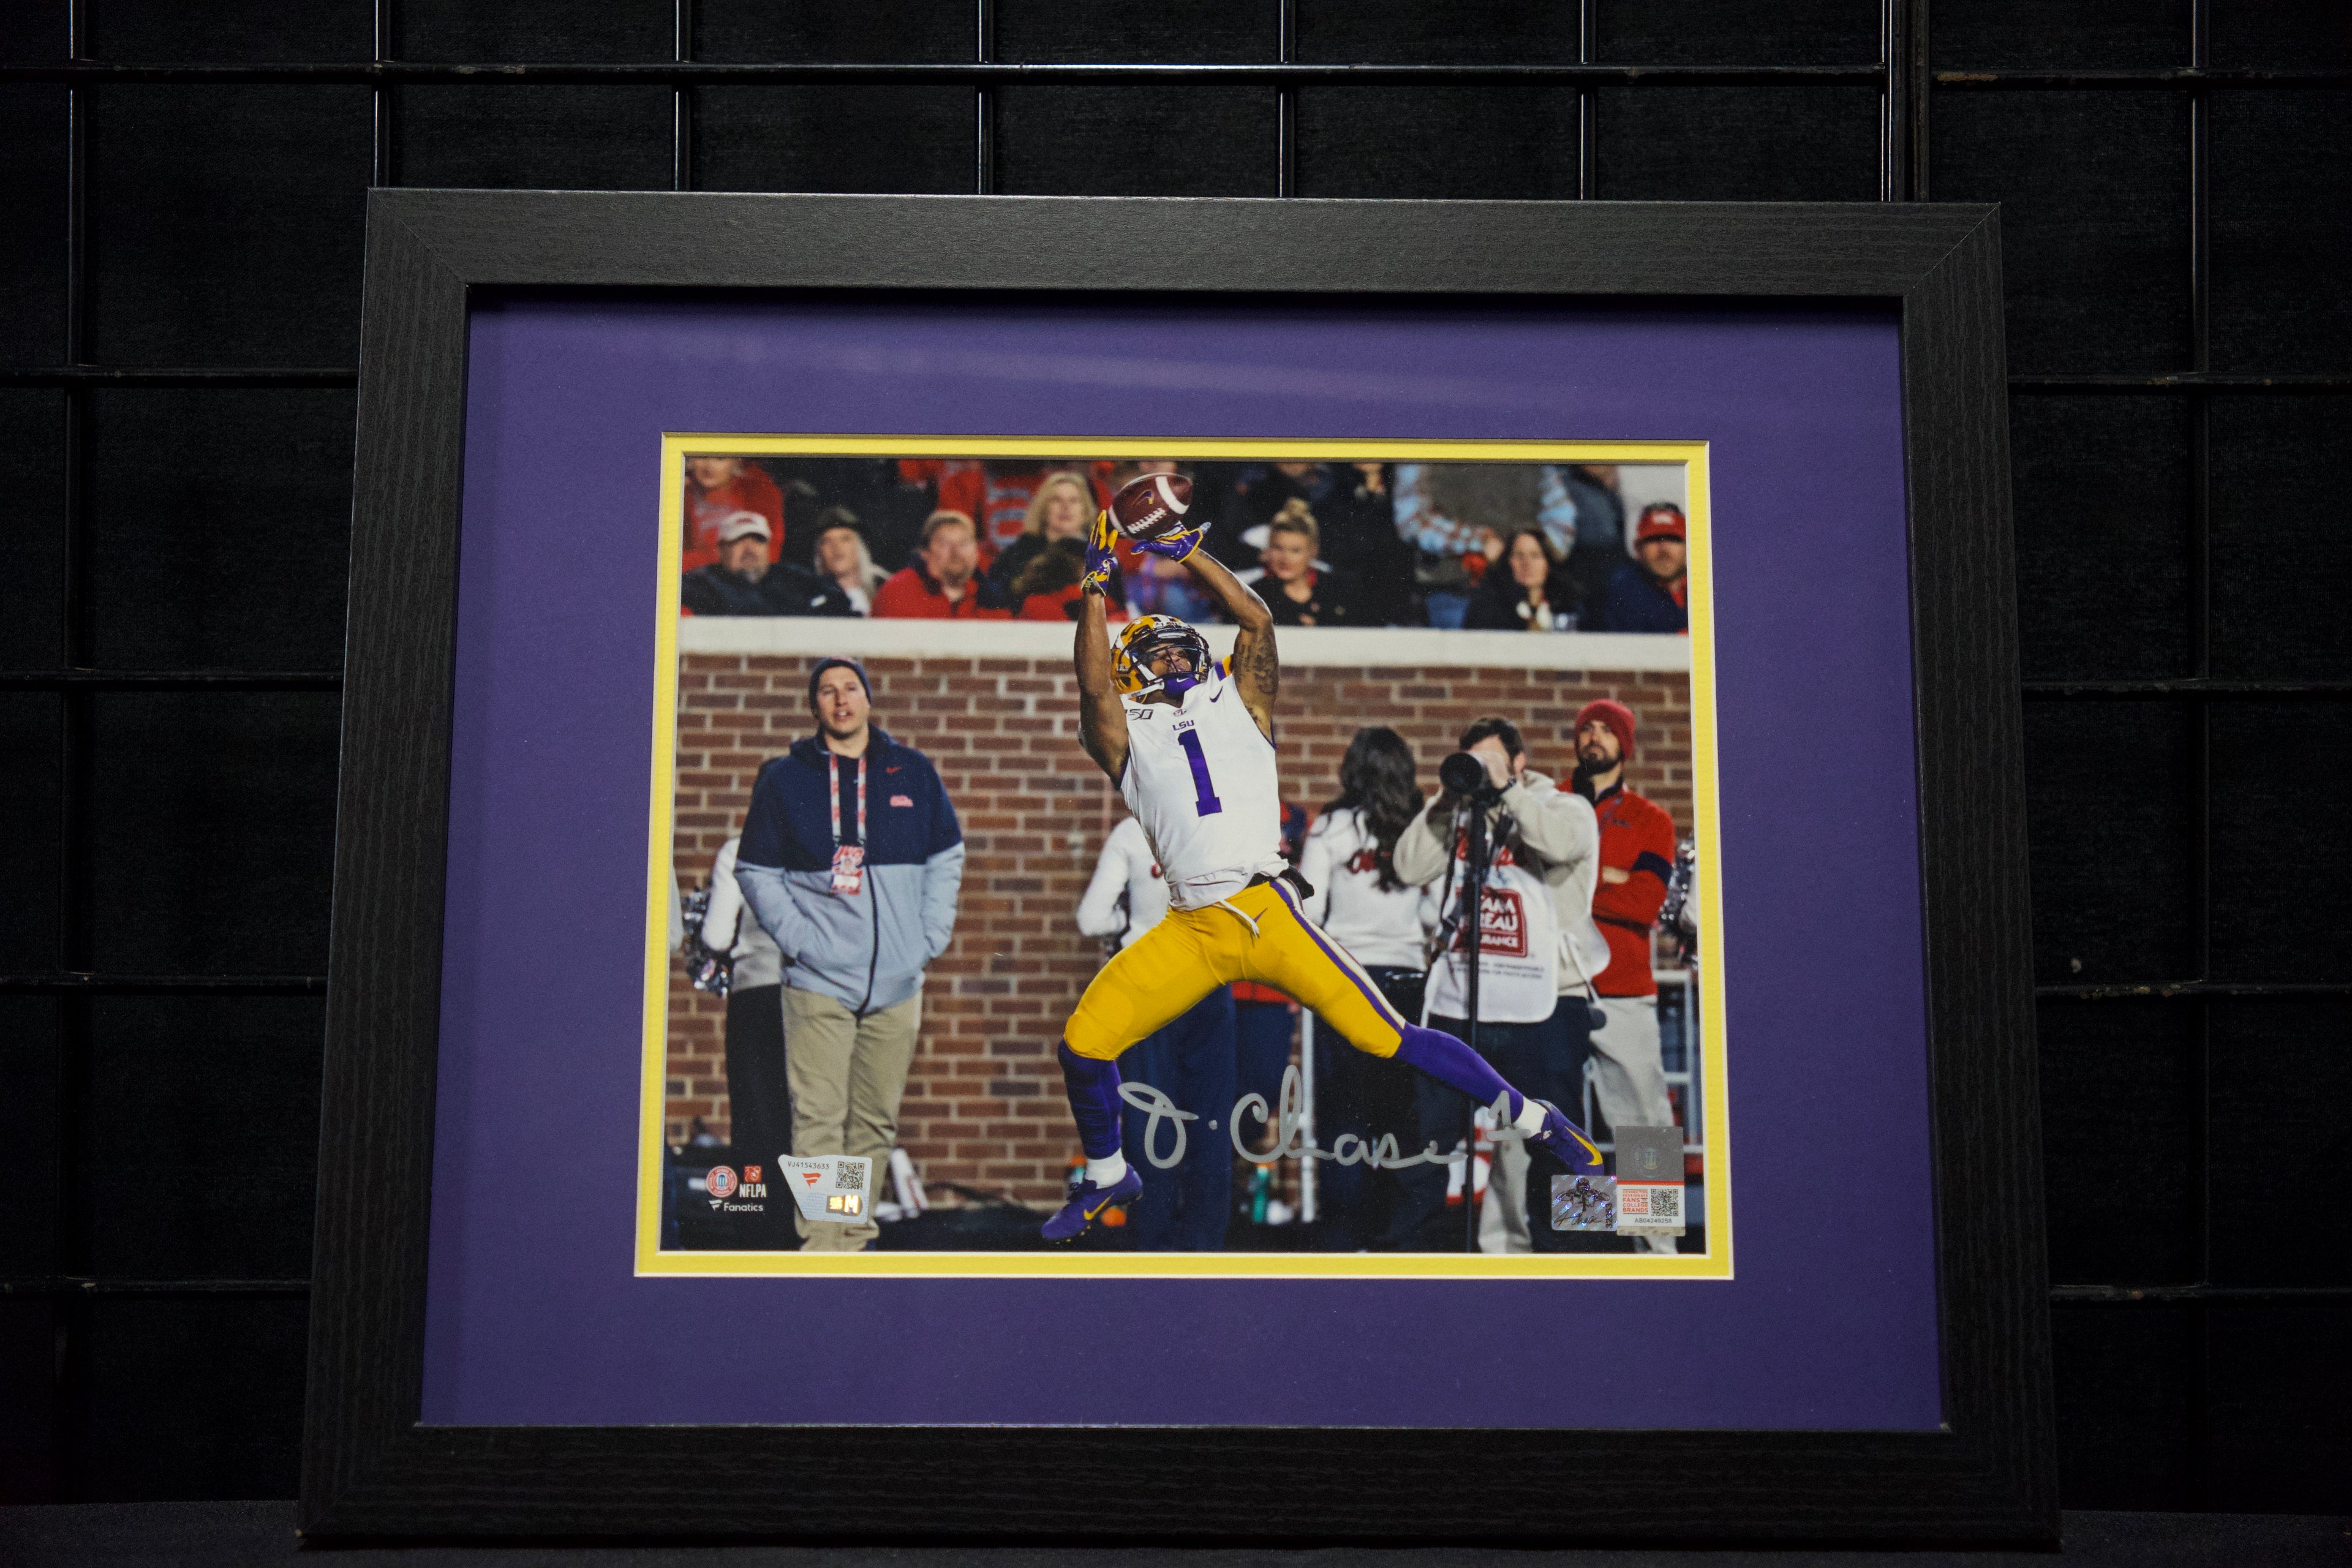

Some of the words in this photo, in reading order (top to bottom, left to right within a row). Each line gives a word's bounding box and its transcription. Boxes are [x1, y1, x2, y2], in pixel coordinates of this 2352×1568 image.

[1172, 720, 1194, 731] LSU
[1178, 729, 1222, 817] 1
[788, 1161, 829, 1170] VJ41543633
[739, 1183, 767, 1198] NFLPA
[723, 1202, 764, 1212] Fanatics
